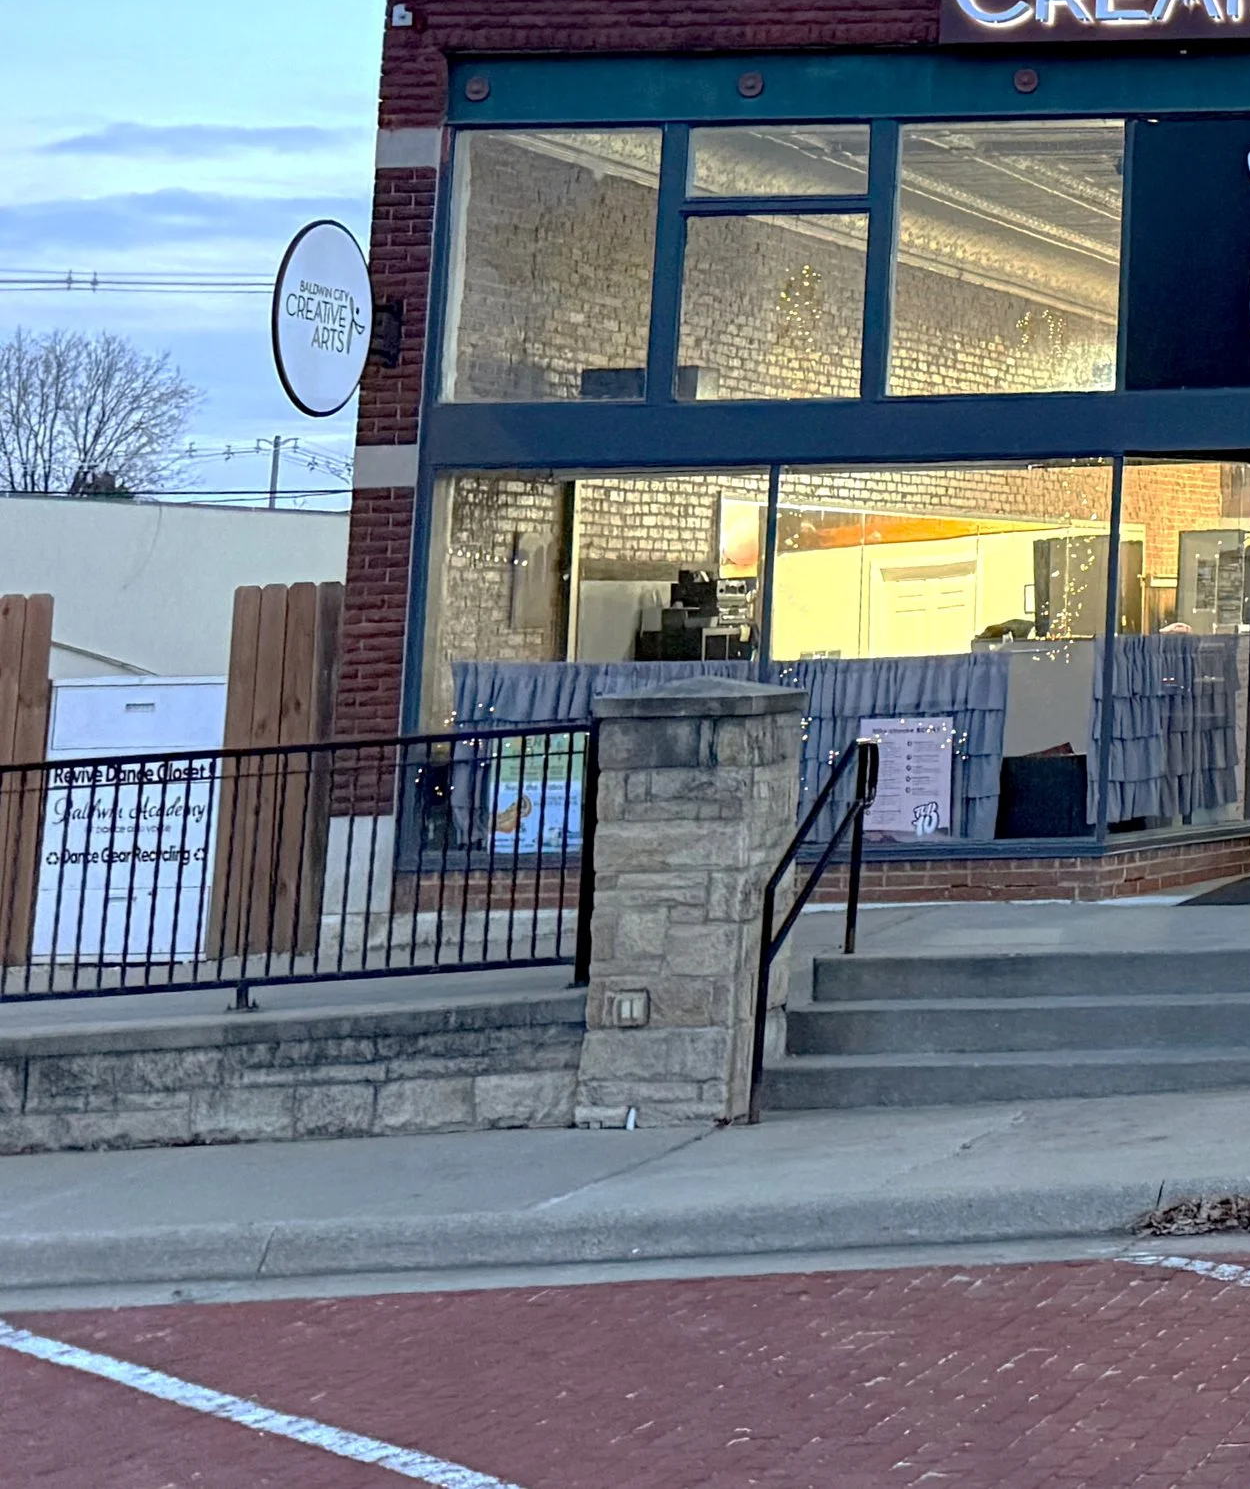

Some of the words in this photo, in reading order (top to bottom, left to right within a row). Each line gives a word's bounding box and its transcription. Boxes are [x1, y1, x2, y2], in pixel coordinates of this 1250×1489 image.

[300, 280, 332, 298] BALDWIN
[334, 289, 349, 301] CITY
[286, 293, 347, 328] CREATIVE
[311, 326, 344, 352] ARTS
[52, 797, 123, 824] Baldw
[62, 848, 98, 864] Dance
[101, 847, 131, 864] Gear
[133, 846, 191, 866] Reccling
